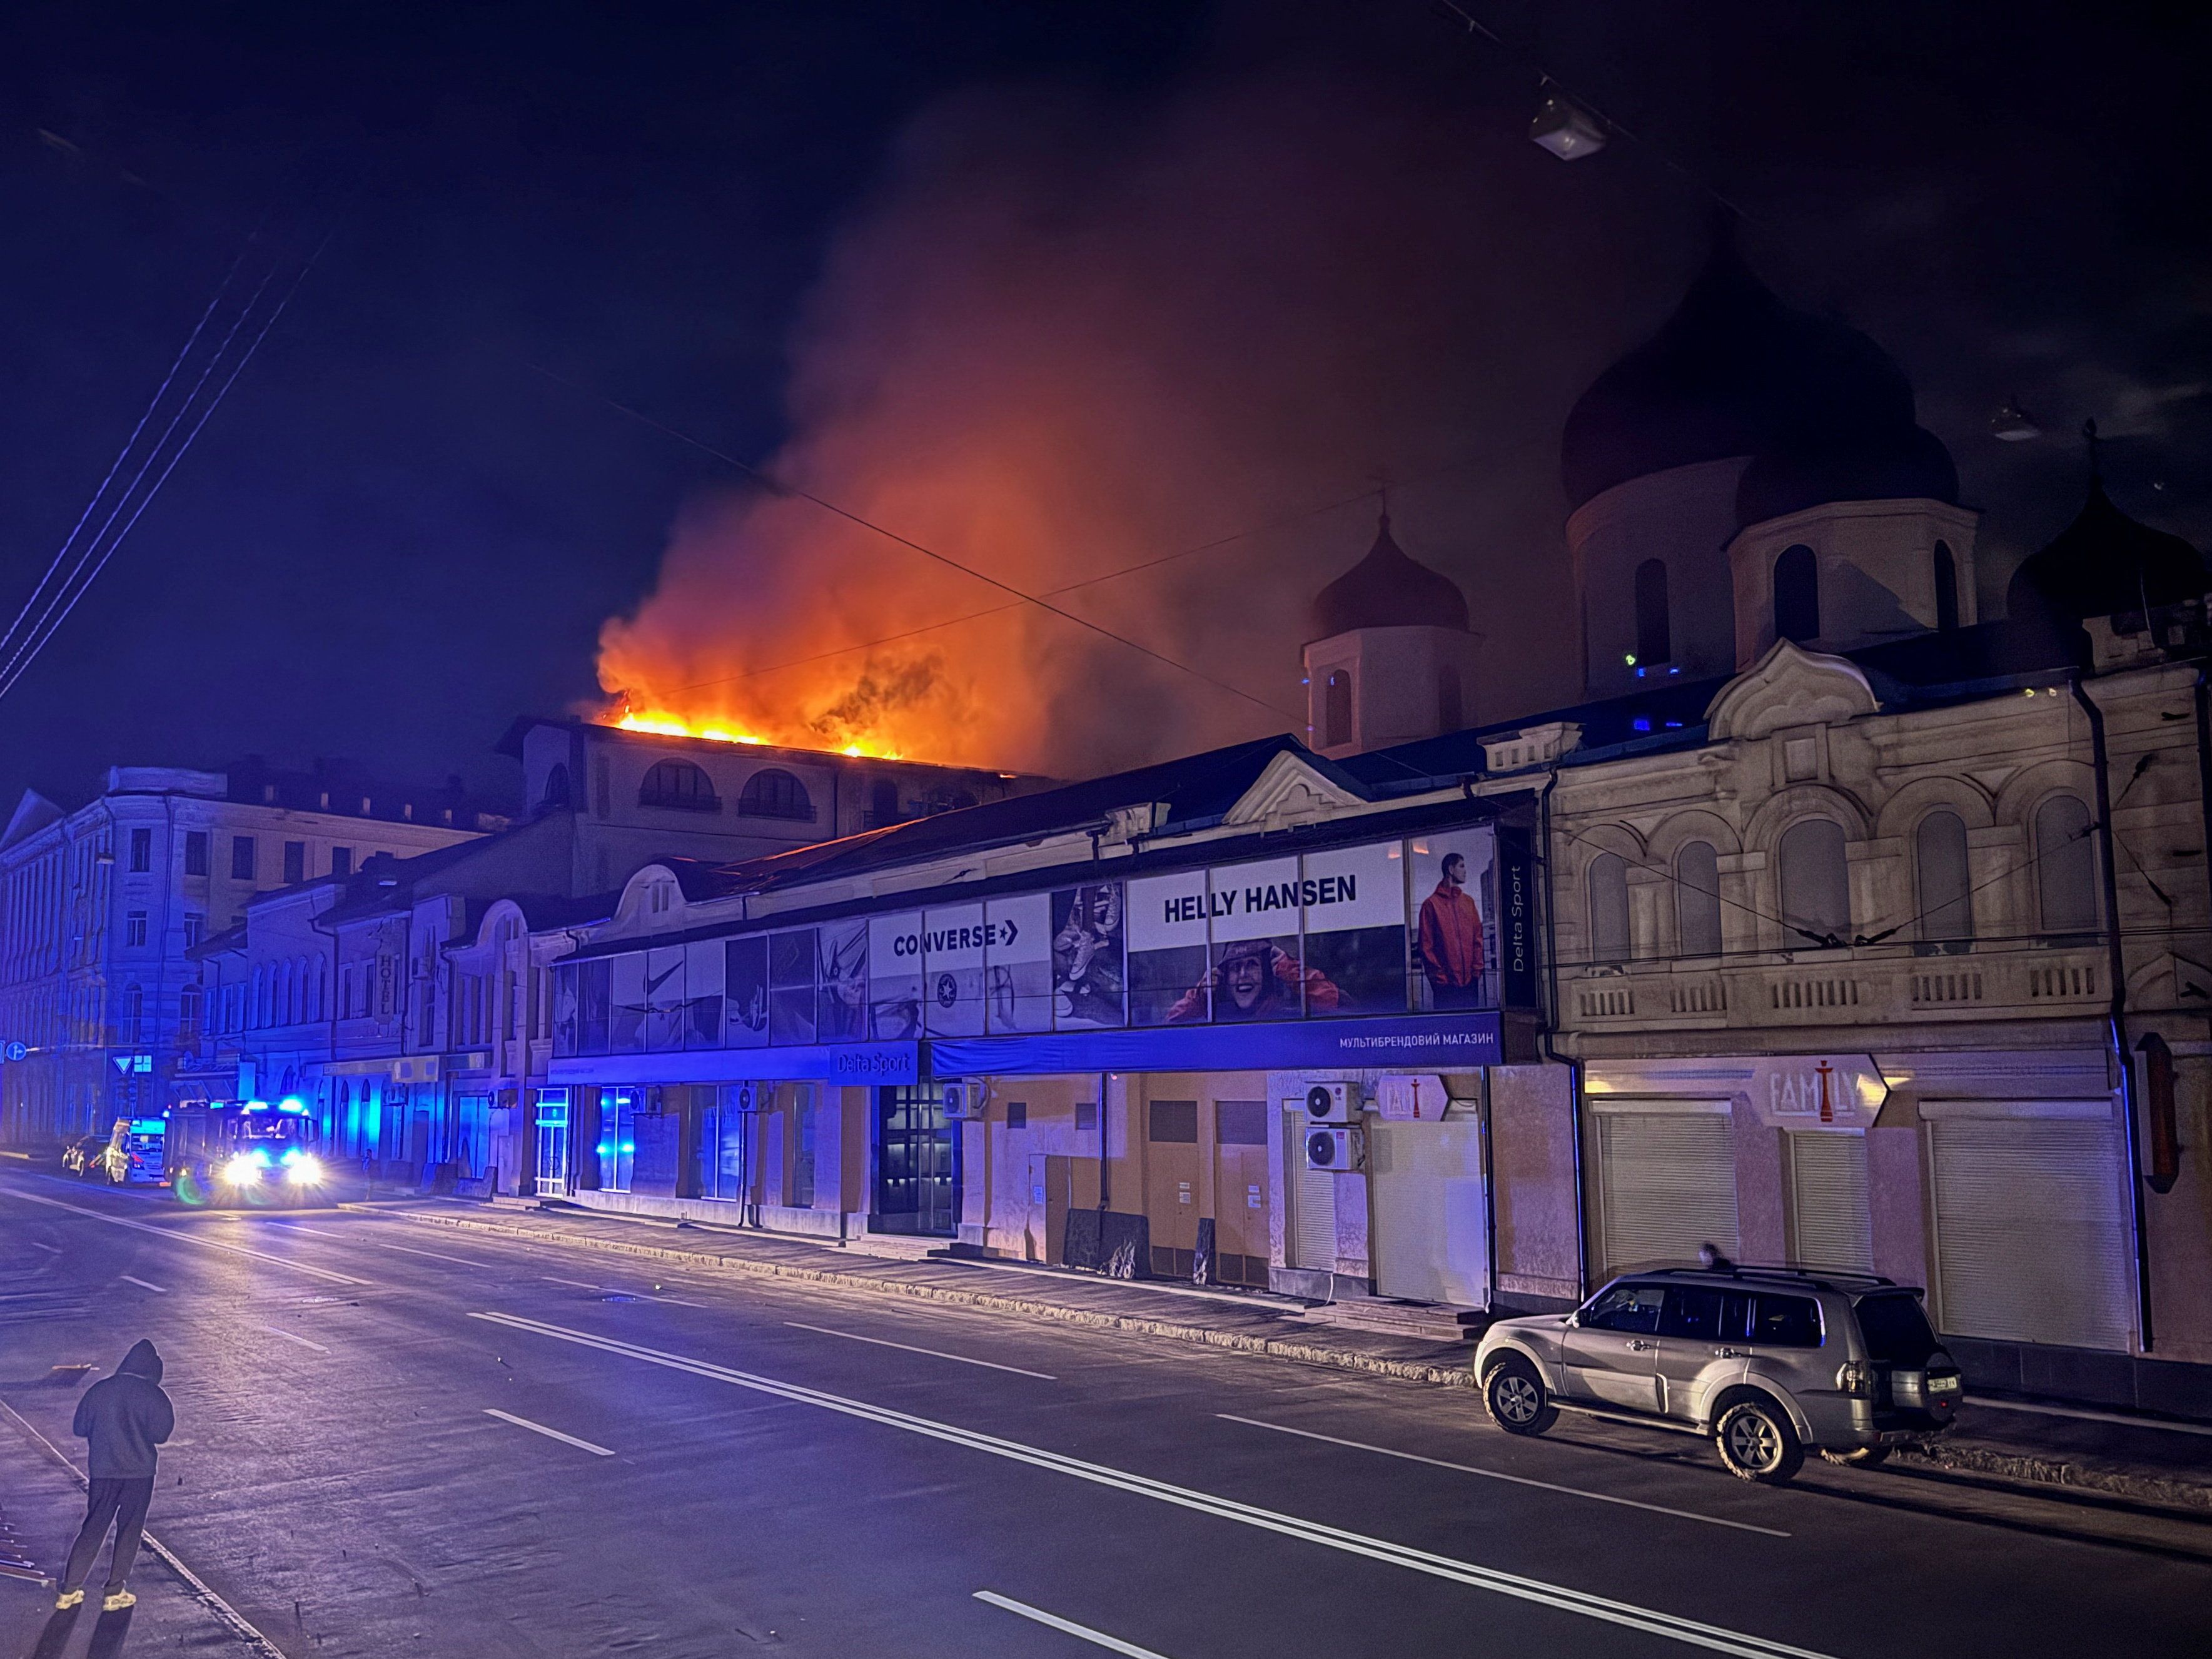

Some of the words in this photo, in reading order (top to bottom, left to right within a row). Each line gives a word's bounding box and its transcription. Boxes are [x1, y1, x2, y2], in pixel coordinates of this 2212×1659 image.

[1164, 890, 1237, 923] HELLY
[1245, 874, 1356, 913] HANSEN
[1511, 865, 1523, 917] Sport
[894, 924, 996, 957] CONVERSE
[1513, 923, 1524, 972] Delta
[380, 955, 391, 1015] HOTEL
[838, 1054, 871, 1073] Delta
[872, 1052, 910, 1076] Sport
[1340, 1033, 1440, 1049] МУЛЬТИБРЕНДОВИЙ
[1443, 1032, 1493, 1045] МАГАЗИН
